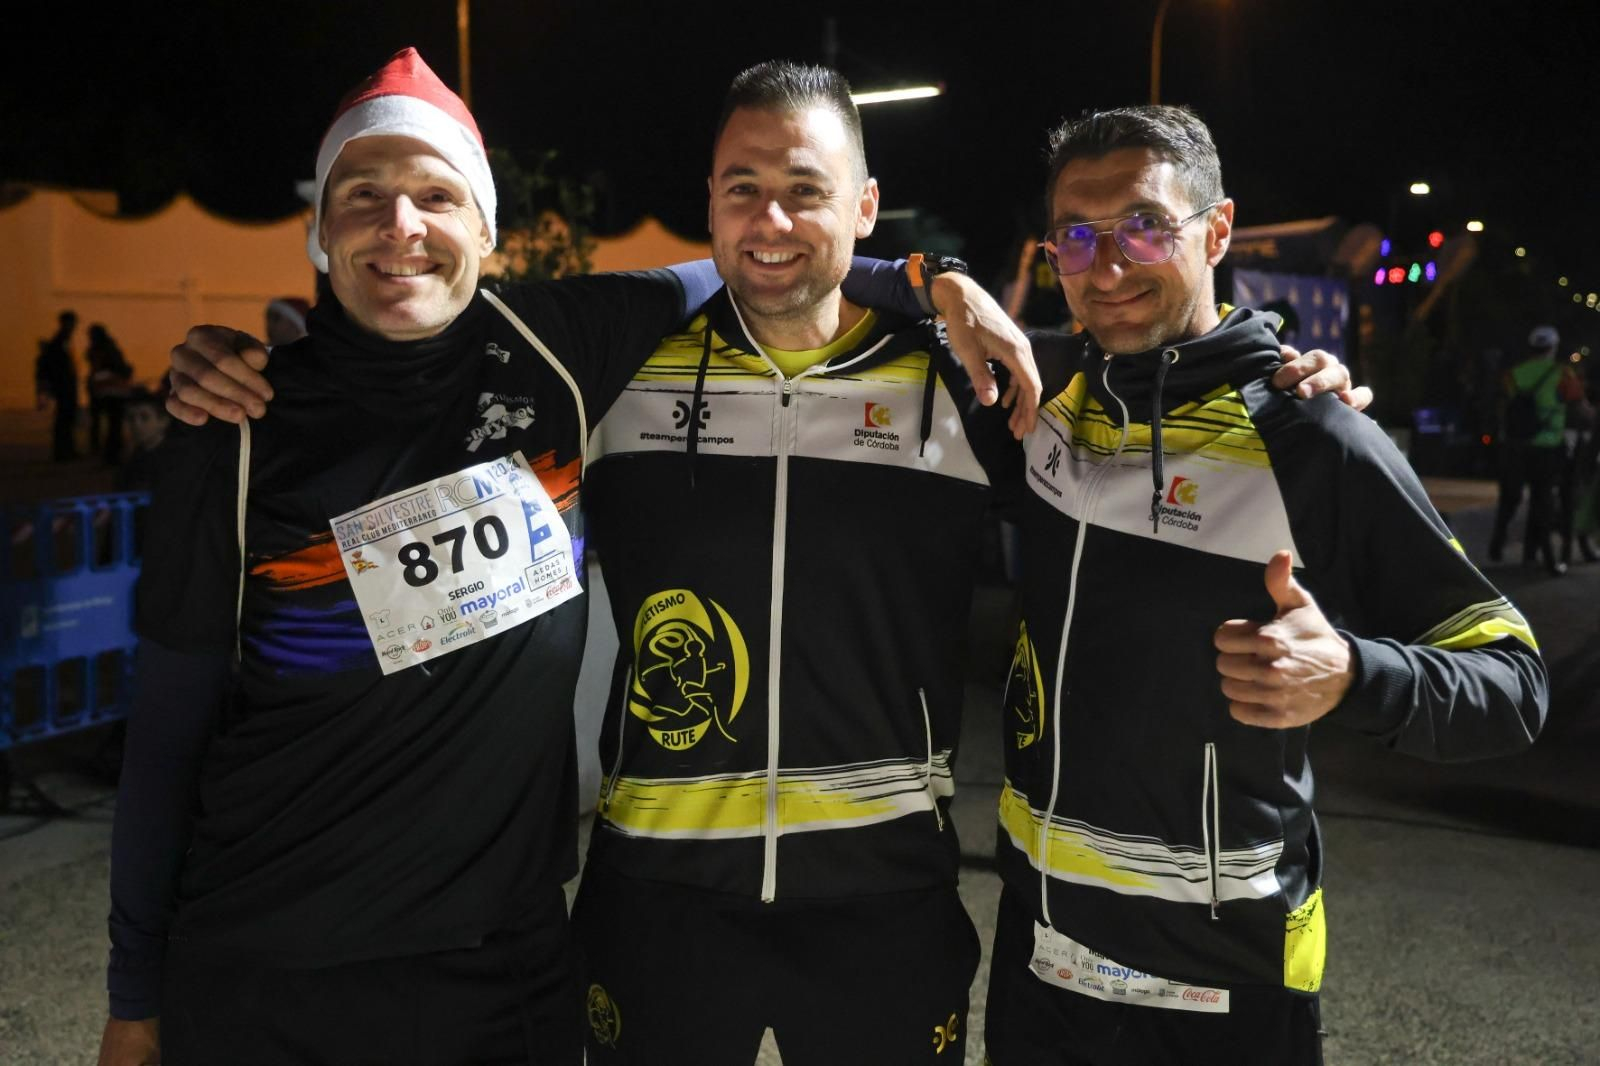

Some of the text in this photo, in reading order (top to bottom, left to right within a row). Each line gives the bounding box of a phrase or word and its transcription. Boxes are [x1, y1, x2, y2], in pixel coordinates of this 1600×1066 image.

[854, 429, 900, 441] Diputación
[854, 438, 900, 451] de Córdoba
[335, 492, 434, 541] SAN SILVESTRE
[1159, 504, 1202, 521] iputación
[1161, 515, 1199, 532] Córdoba
[341, 538, 361, 549] REAL
[361, 529, 381, 542] CLUB
[398, 514, 510, 588] 870
[448, 580, 485, 601] SERGIO
[460, 576, 526, 616] mayoral
[439, 611, 457, 624] YOU
[440, 626, 476, 645] Electrolit
[661, 729, 696, 747] RUTE
